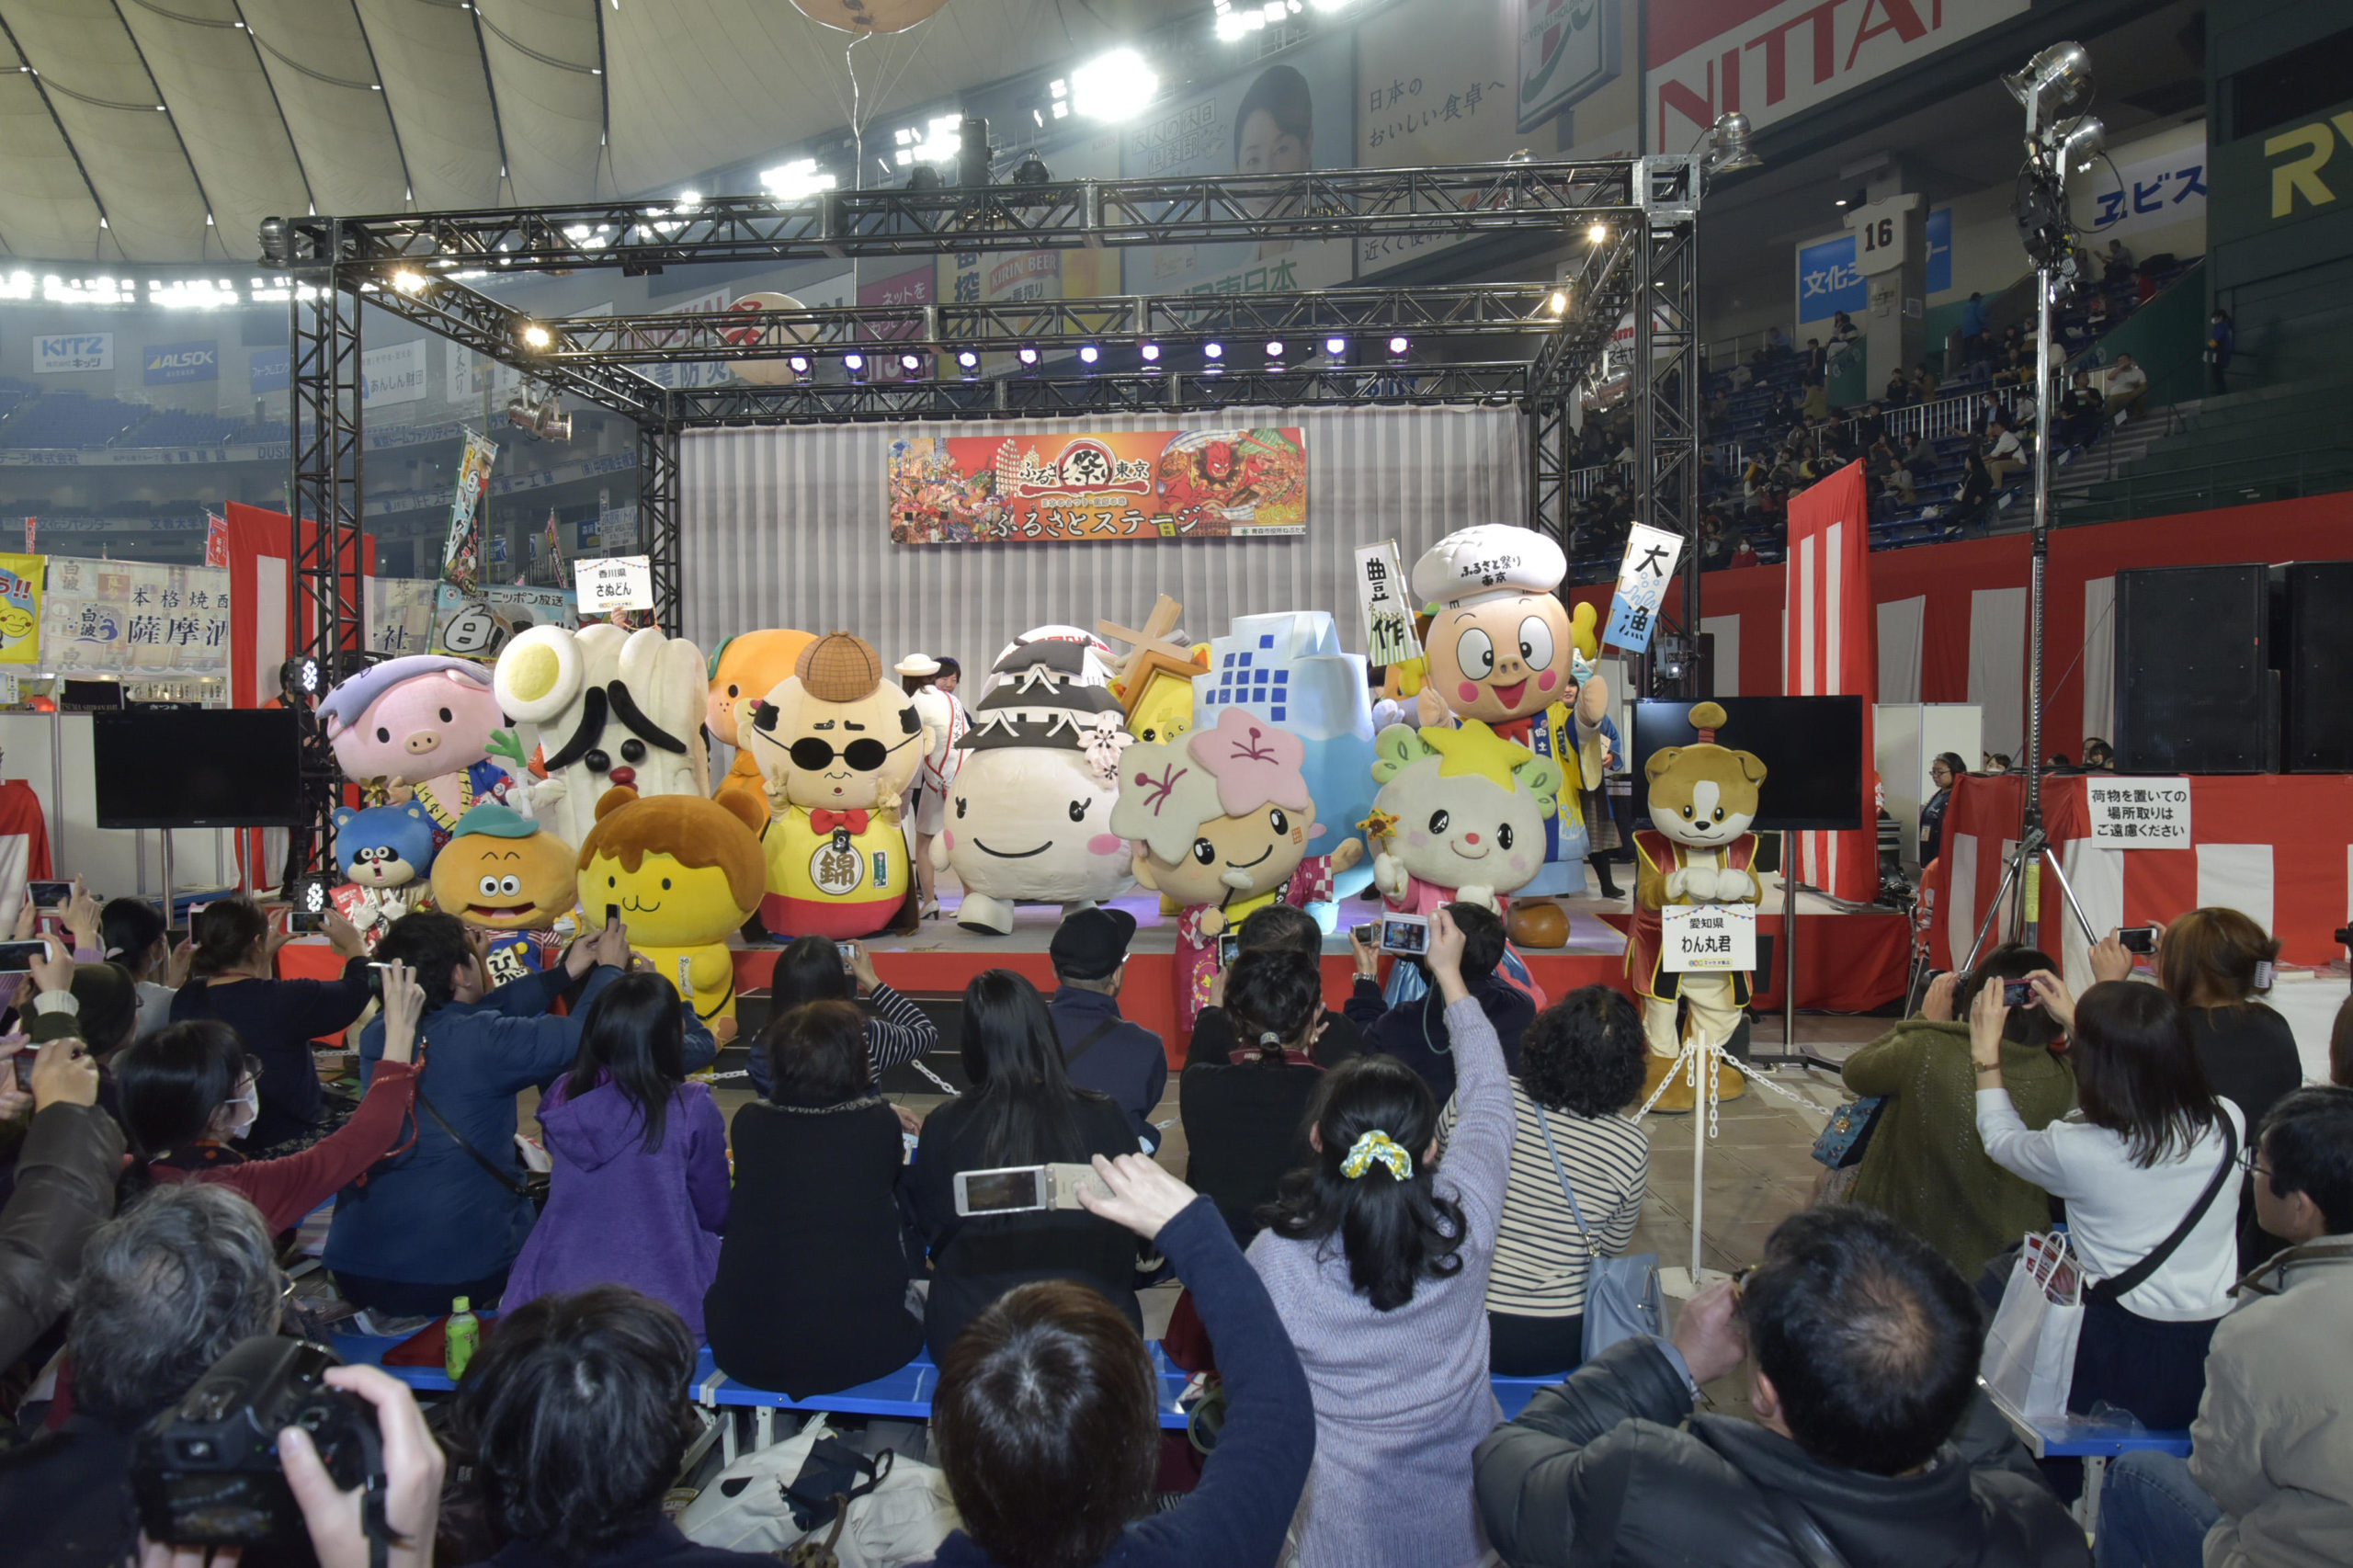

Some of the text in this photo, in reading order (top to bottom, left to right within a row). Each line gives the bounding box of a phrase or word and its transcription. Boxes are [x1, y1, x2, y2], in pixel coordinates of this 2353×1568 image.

[1369, 77, 1424, 112] 日本の
[1369, 80, 1506, 148] おいしい食卓へ
[1865, 218, 1893, 252] 16
[991, 254, 1057, 289] KIRIN BEER
[42, 336, 104, 357] KITZ
[161, 350, 213, 368] ALSOK
[369, 369, 425, 393] あんしん財団
[990, 506, 1203, 539] ふるさとステージ
[598, 567, 627, 579] 香川県
[1461, 554, 1521, 578] ふるさと祭り
[1481, 572, 1506, 587] 東京
[596, 582, 632, 597] さぬどん
[491, 591, 563, 608] ニッポン放送
[2091, 790, 2188, 802] 荷物を置いての
[2108, 806, 2174, 820] 場所取りは
[2097, 824, 2185, 837] ご遠慮ください
[819, 850, 856, 887] 錦
[1689, 917, 1724, 929] 愛知県
[1681, 935, 1732, 953] わん丸君
